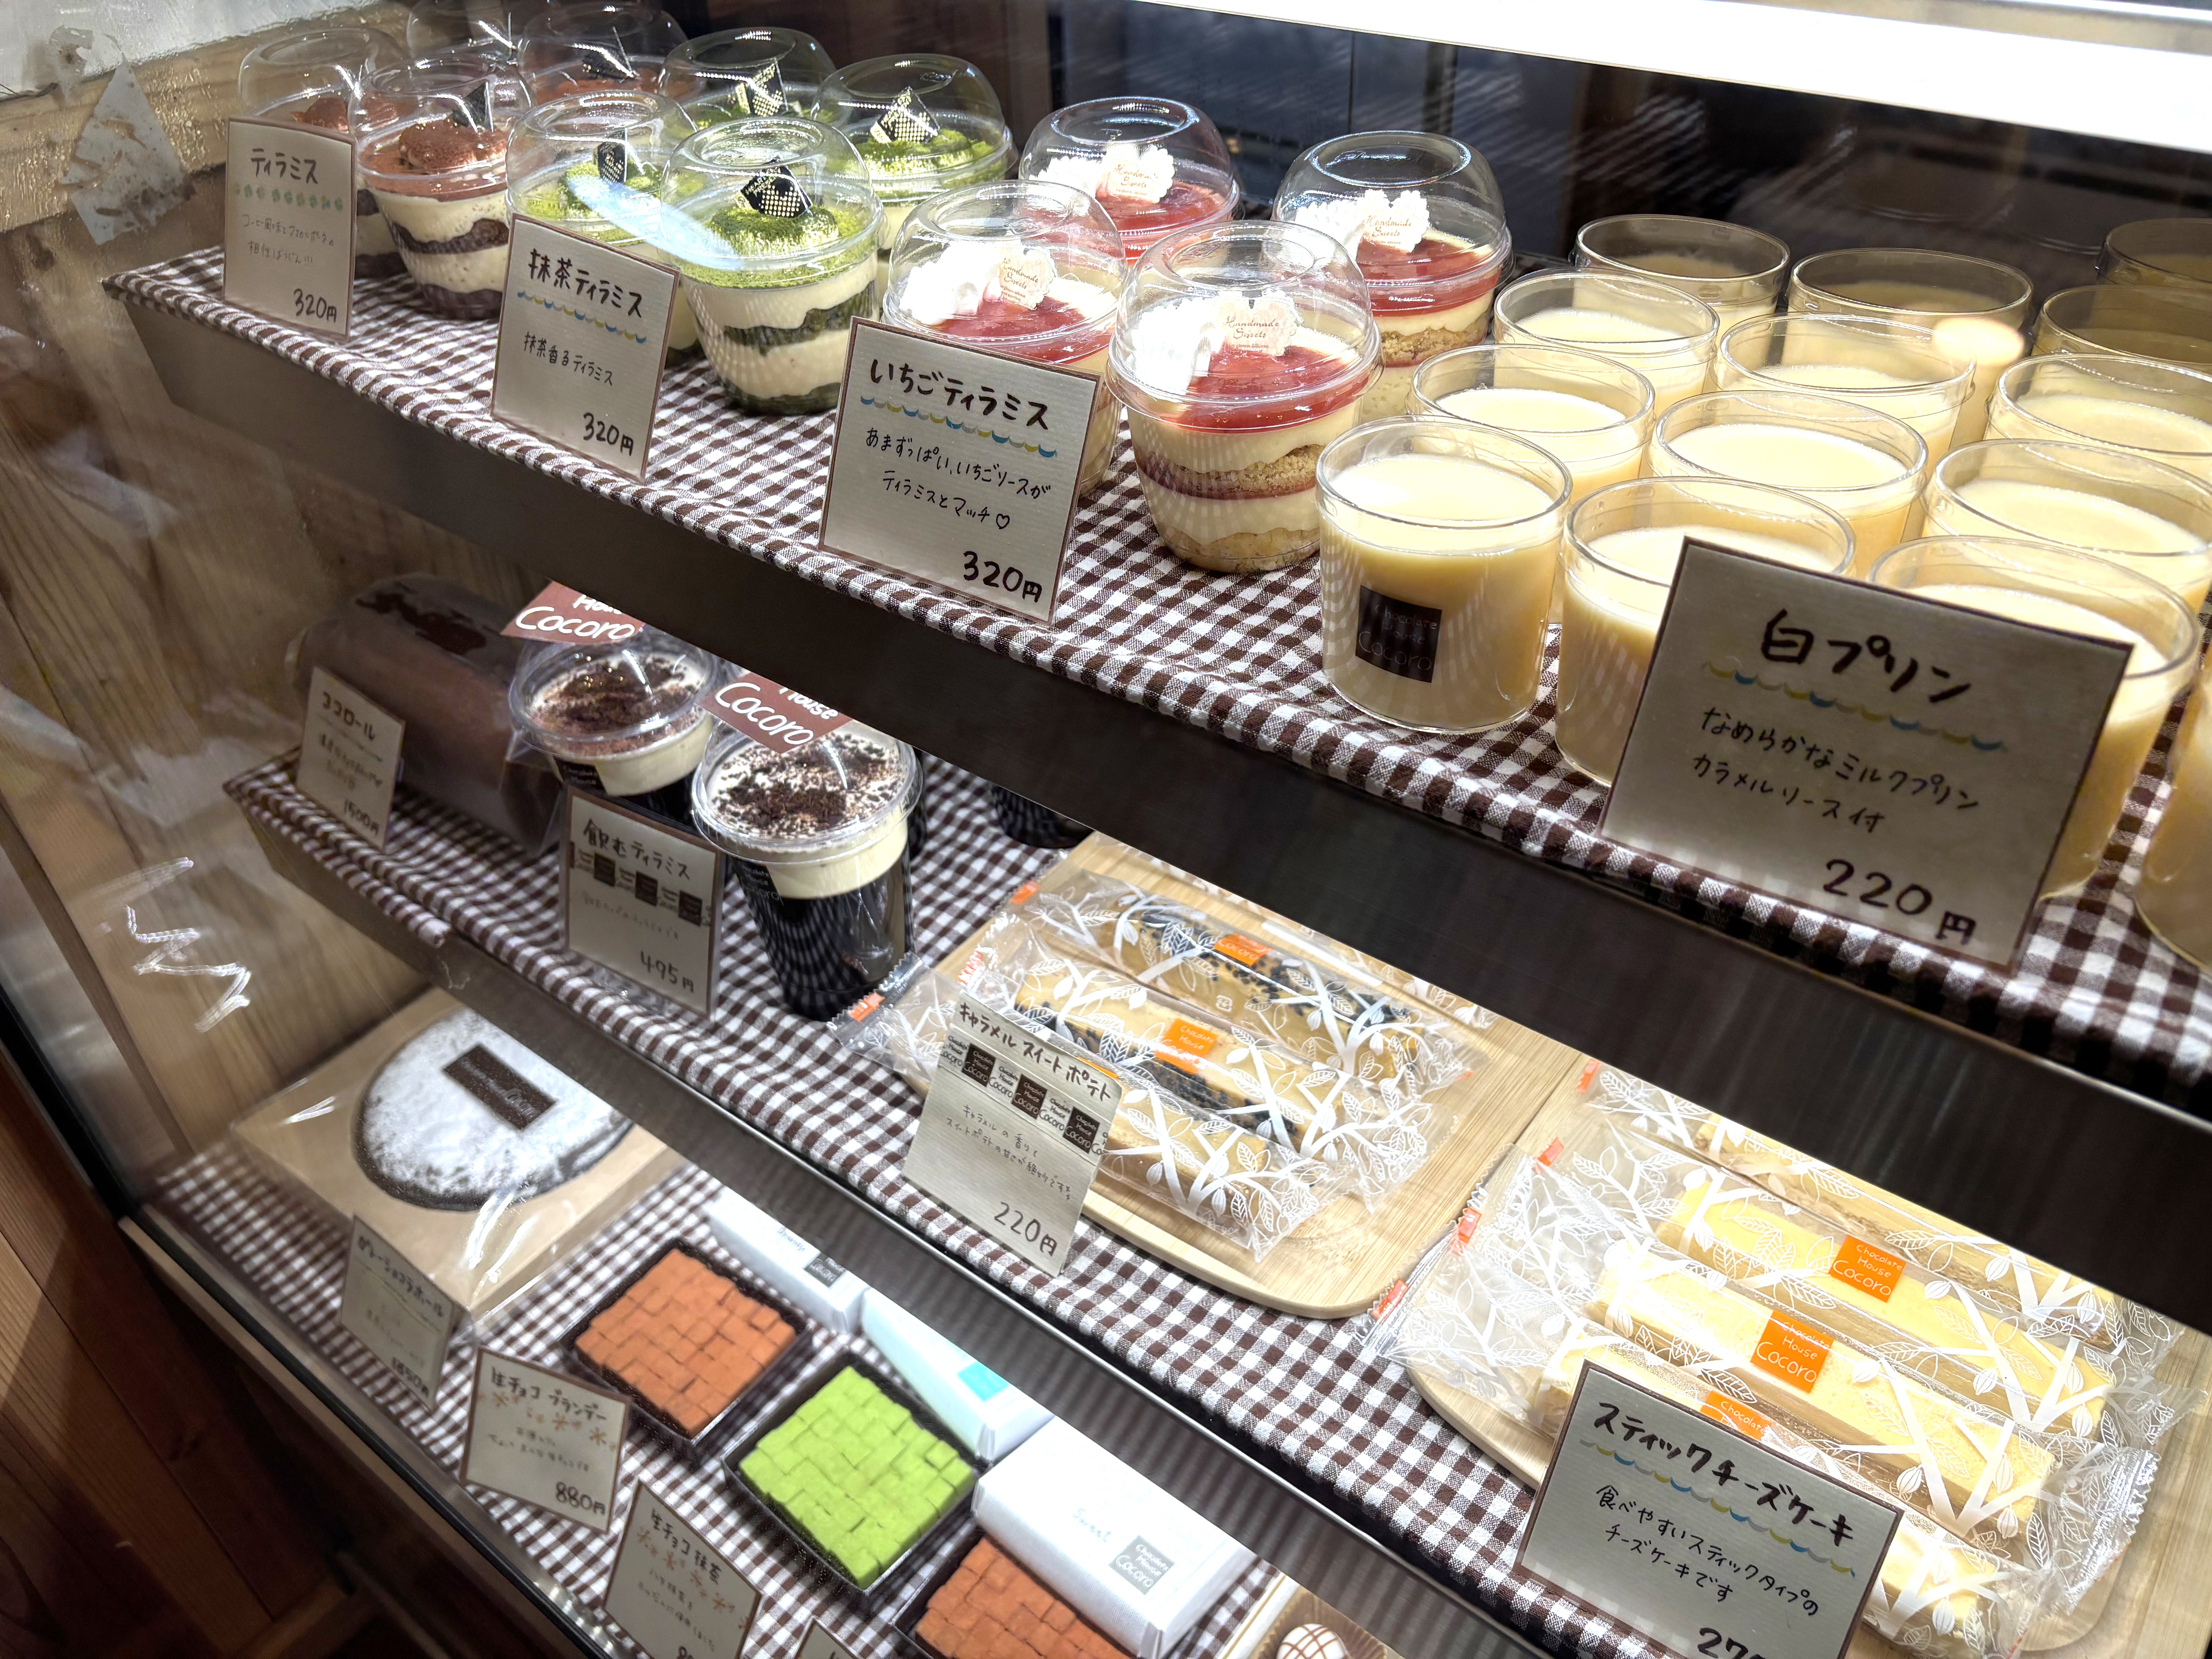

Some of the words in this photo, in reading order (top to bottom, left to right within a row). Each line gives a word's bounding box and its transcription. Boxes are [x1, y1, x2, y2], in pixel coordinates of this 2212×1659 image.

[251, 148, 318, 184] ティラミス
[529, 249, 642, 318] 抹茶ティラミス
[294, 289, 337, 323] 320円
[1223, 316, 1279, 328] Handmade
[1233, 328, 1266, 339] Sweets
[524, 332, 613, 386] 抹茶香るティラミス
[871, 359, 1048, 430] いちごティラミス
[583, 412, 634, 456] 320円
[963, 551, 1042, 603] 320円
[516, 606, 635, 639] Cocoro
[1358, 631, 1432, 670] Cocoro
[1761, 609, 1972, 703] 白プリン
[323, 690, 375, 741] ココロール
[715, 682, 814, 745] Cocoro
[1701, 706, 1978, 811] なめらかなミルクプリン
[583, 818, 690, 880] 飲むティラミス
[1822, 859, 1977, 946] 220円
[641, 950, 694, 993] 495円
[1179, 1036, 1204, 1050] House
[964, 1061, 989, 1082] Cocoro
[989, 1076, 1013, 1098] Cocoro
[1013, 1093, 1039, 1114] Cocoro
[1024, 1089, 1040, 1103] House
[1050, 1105, 1066, 1119] House
[1039, 1109, 1065, 1131] Cocoro
[1065, 1126, 1091, 1148] Cocoro
[1075, 1122, 1092, 1136] House
[994, 1201, 1058, 1257] 220円
[1856, 1245, 1903, 1271] Chocolate
[1858, 1256, 1892, 1278] House
[1833, 1259, 1891, 1296] Cocoro
[1756, 1341, 1817, 1383] Cocoro
[1782, 1334, 1817, 1360] House
[1721, 1401, 1765, 1434] Chocolate
[1594, 1402, 1854, 1547] スティックチーズケーキ
[556, 1481, 606, 1516] 880円
[1072, 1506, 1113, 1543] Sweet
[1596, 1485, 1819, 1616] 食べやすいスティックタイプの
[1606, 1523, 1733, 1602] チーズケーキです
[1115, 1554, 1154, 1588] Cocoro
[1697, 1627, 1766, 1659] 27
